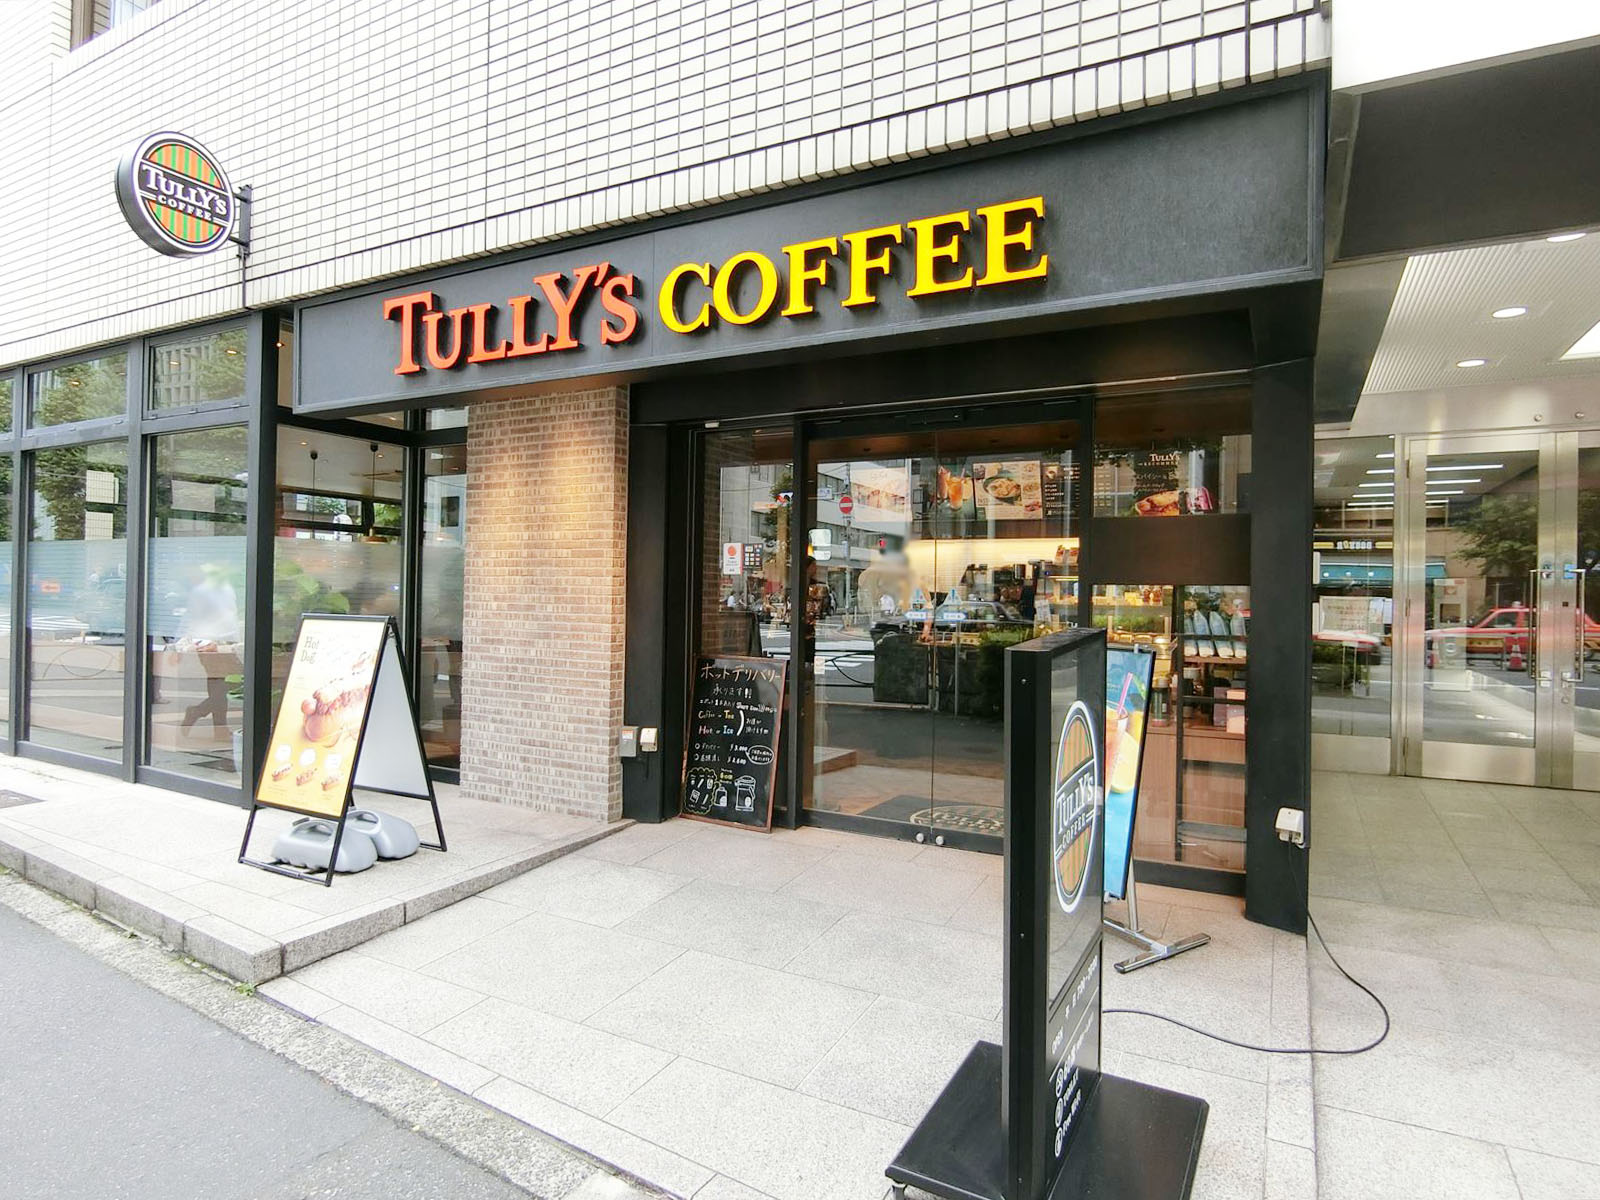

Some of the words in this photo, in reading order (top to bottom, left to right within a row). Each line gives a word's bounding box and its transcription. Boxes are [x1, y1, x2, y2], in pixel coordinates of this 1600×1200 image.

[158, 195, 212, 221] COFFEE
[658, 196, 1049, 333] COFFEE
[701, 663, 781, 683] ホットデリバリー
[1062, 813, 1085, 849] COFFEE
